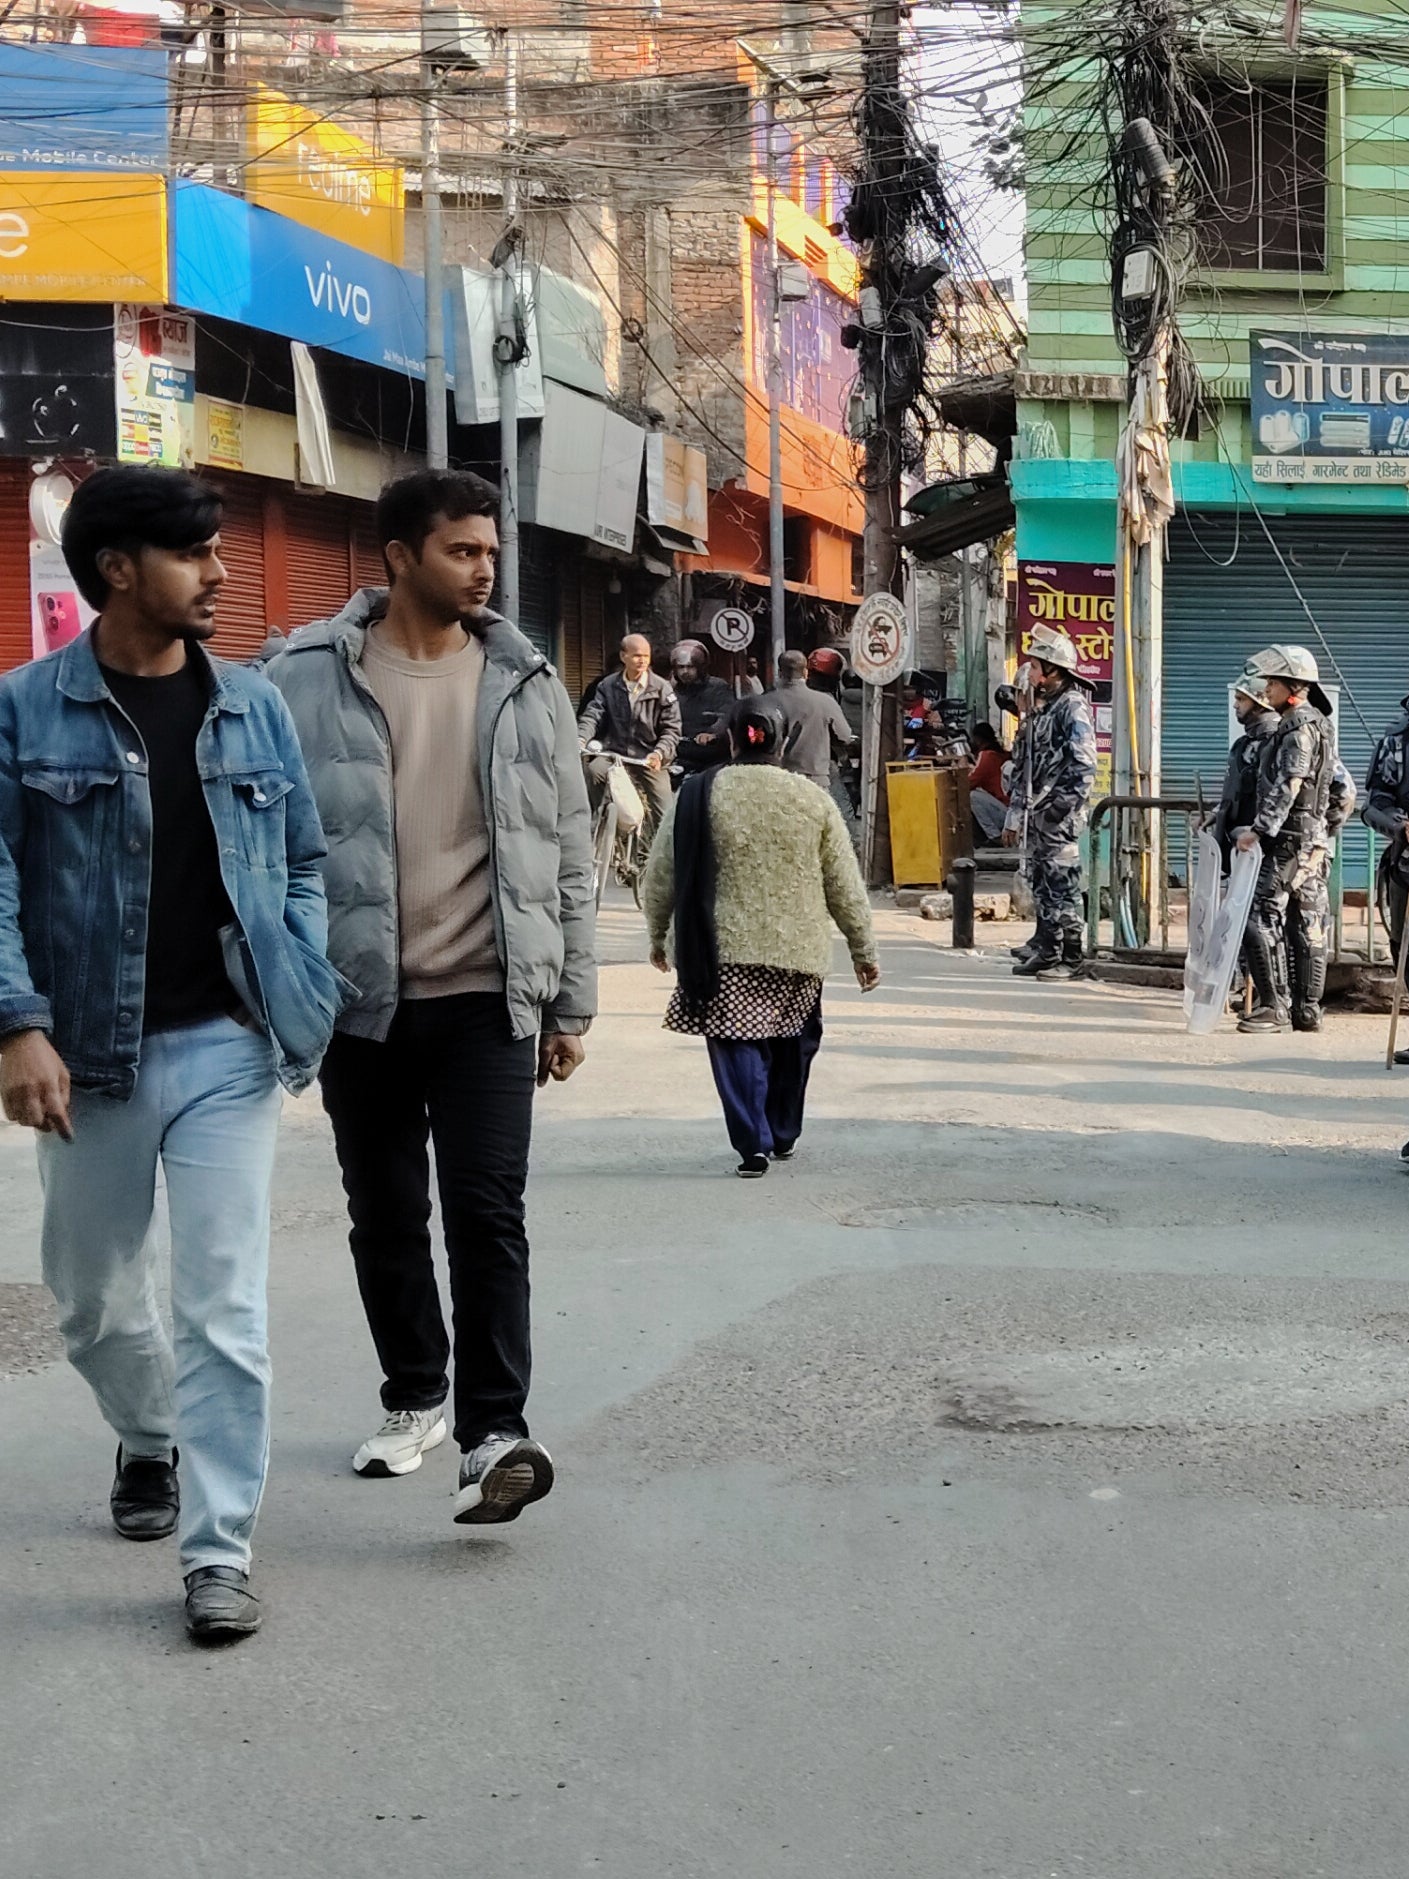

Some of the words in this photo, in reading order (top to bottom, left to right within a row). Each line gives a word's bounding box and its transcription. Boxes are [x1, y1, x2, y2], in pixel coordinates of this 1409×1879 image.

[22, 148, 87, 164] Mobile
[93, 150, 160, 167] Center
[298, 142, 371, 216] realme
[304, 260, 371, 326] vivo
[1353, 464, 1371, 478] तथा
[1075, 627, 1115, 662] स्टो
